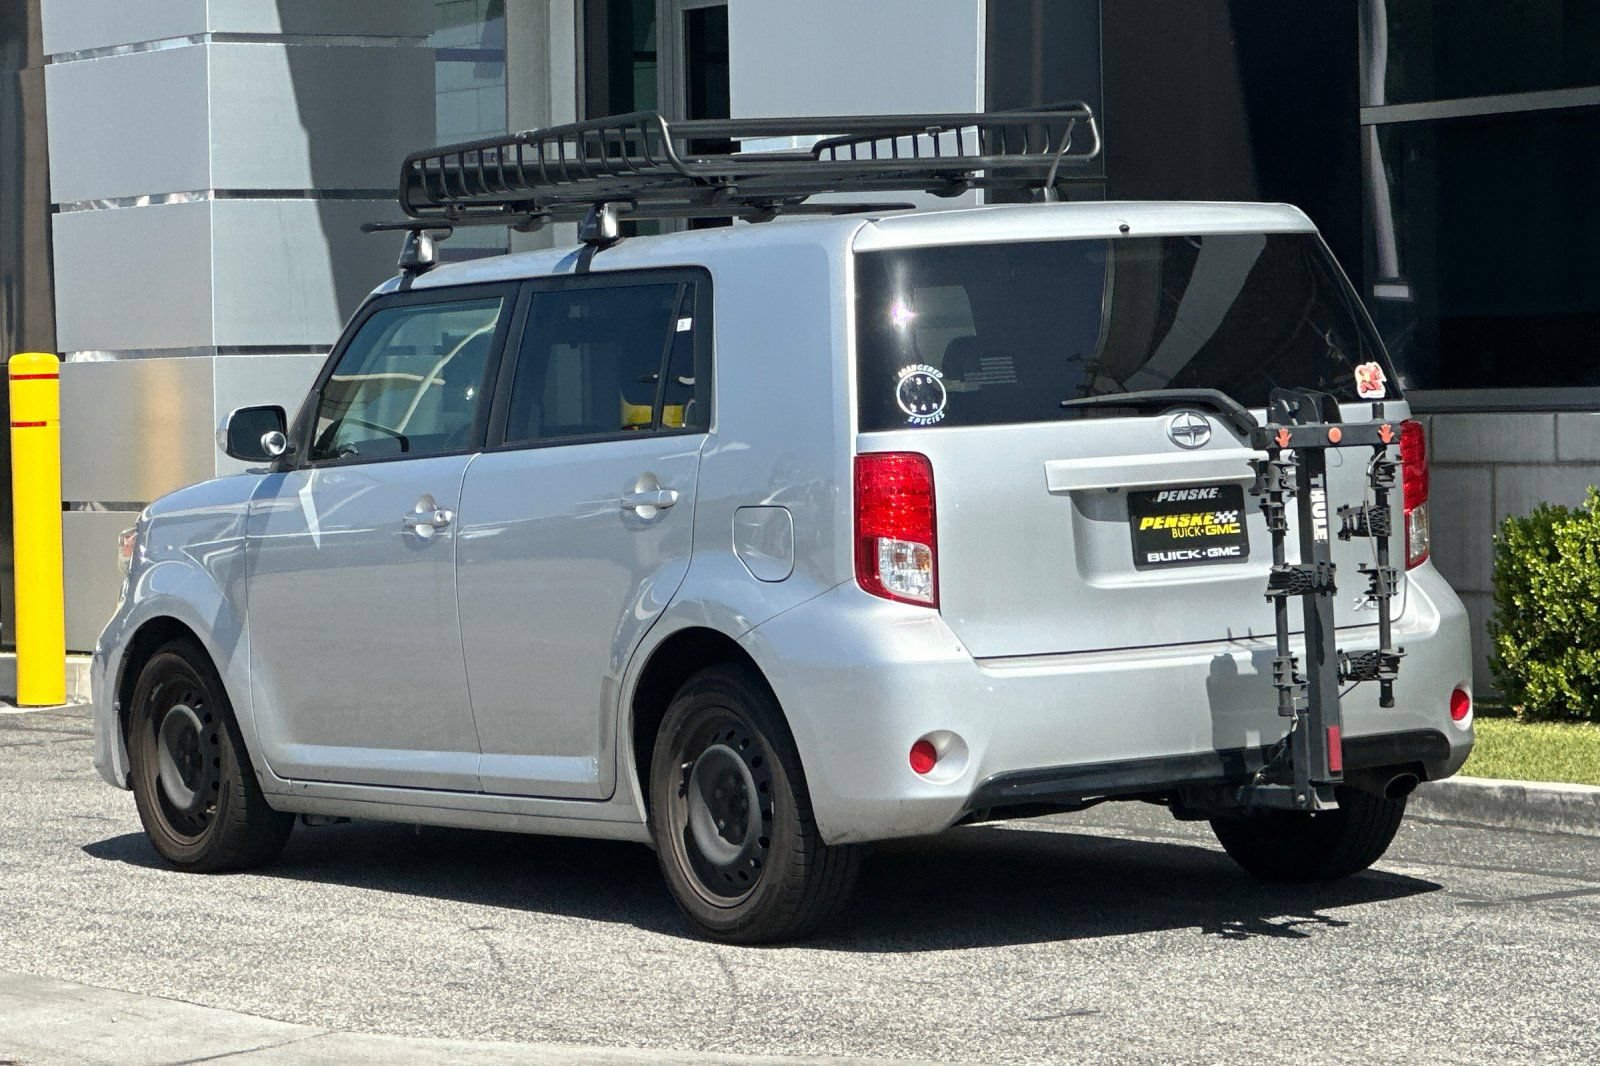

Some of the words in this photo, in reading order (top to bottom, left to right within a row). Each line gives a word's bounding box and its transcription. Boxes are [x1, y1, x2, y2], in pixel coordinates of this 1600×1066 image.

[907, 410, 945, 425] SPECIES
[1157, 487, 1219, 502] PENSKE
[1309, 473, 1329, 540] THULE
[1140, 511, 1216, 530] PENSKE
